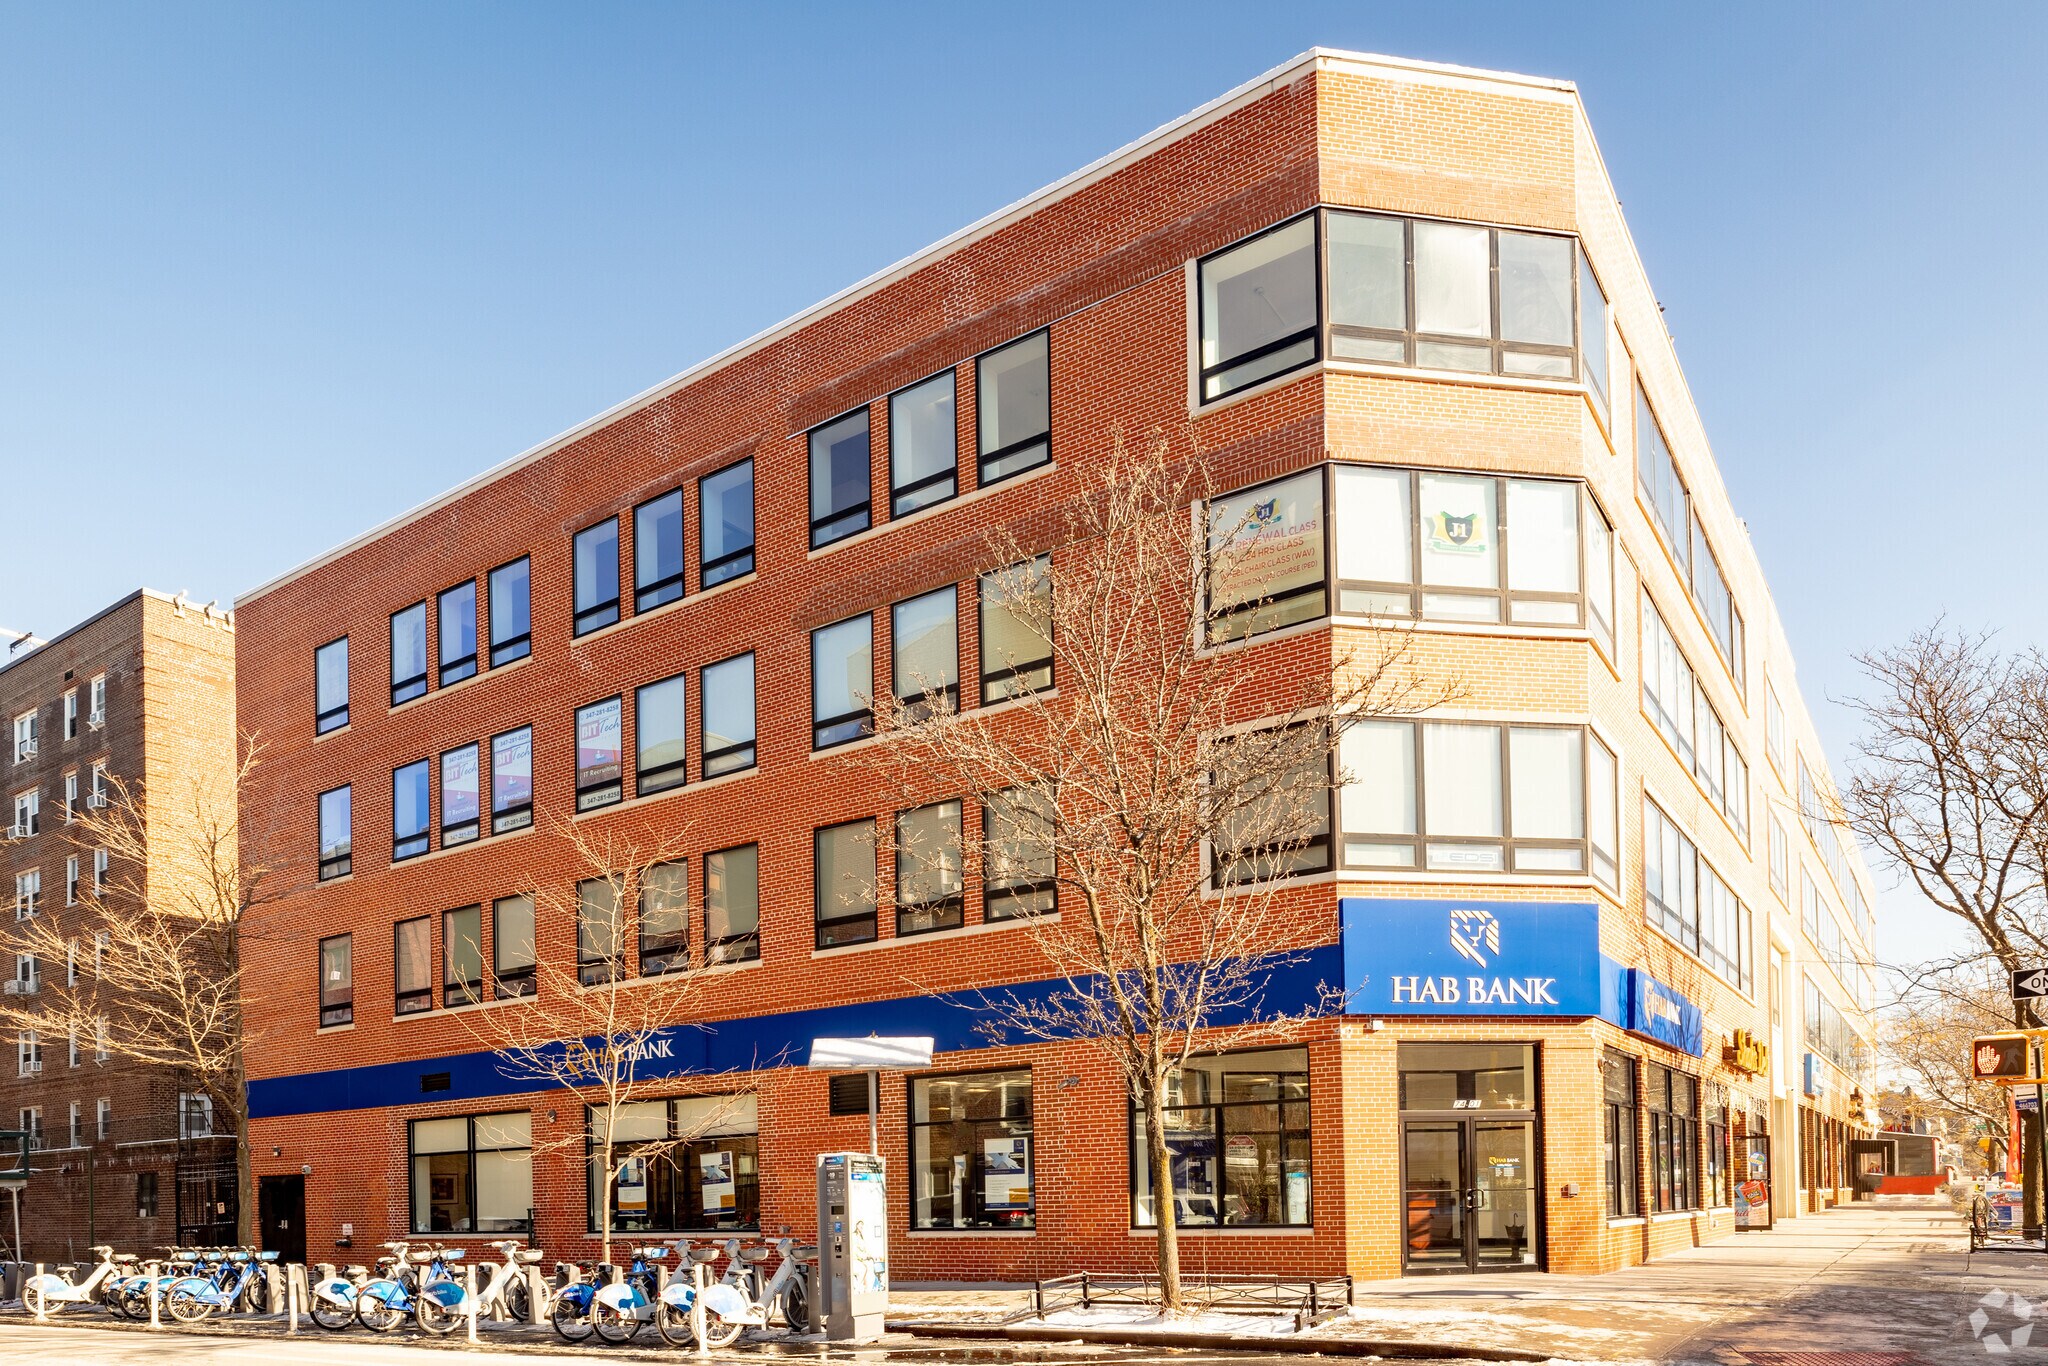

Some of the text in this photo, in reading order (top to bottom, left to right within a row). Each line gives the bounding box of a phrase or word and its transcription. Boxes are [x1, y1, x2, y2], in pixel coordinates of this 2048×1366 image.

[1288, 520, 1317, 537] CLASS
[1258, 545, 1275, 557] HRS
[1276, 536, 1304, 552] CLASS
[1267, 554, 1291, 568] CLASS
[1291, 547, 1315, 561] (WAV)
[1276, 564, 1300, 577] COURSE
[1301, 559, 1318, 571] (PED)
[585, 704, 619, 720] 347-281-8258
[581, 716, 620, 740] BIT Tech
[496, 744, 531, 768] BIT Tech
[460, 762, 477, 777] Tech
[589, 764, 618, 777] Recruiting
[502, 789, 529, 802] Recruiting
[586, 790, 620, 805] 347-281-8258
[452, 804, 477, 816] Recruiting
[1391, 976, 1559, 1005] HAB BANK
[627, 1038, 676, 1062] BANK
